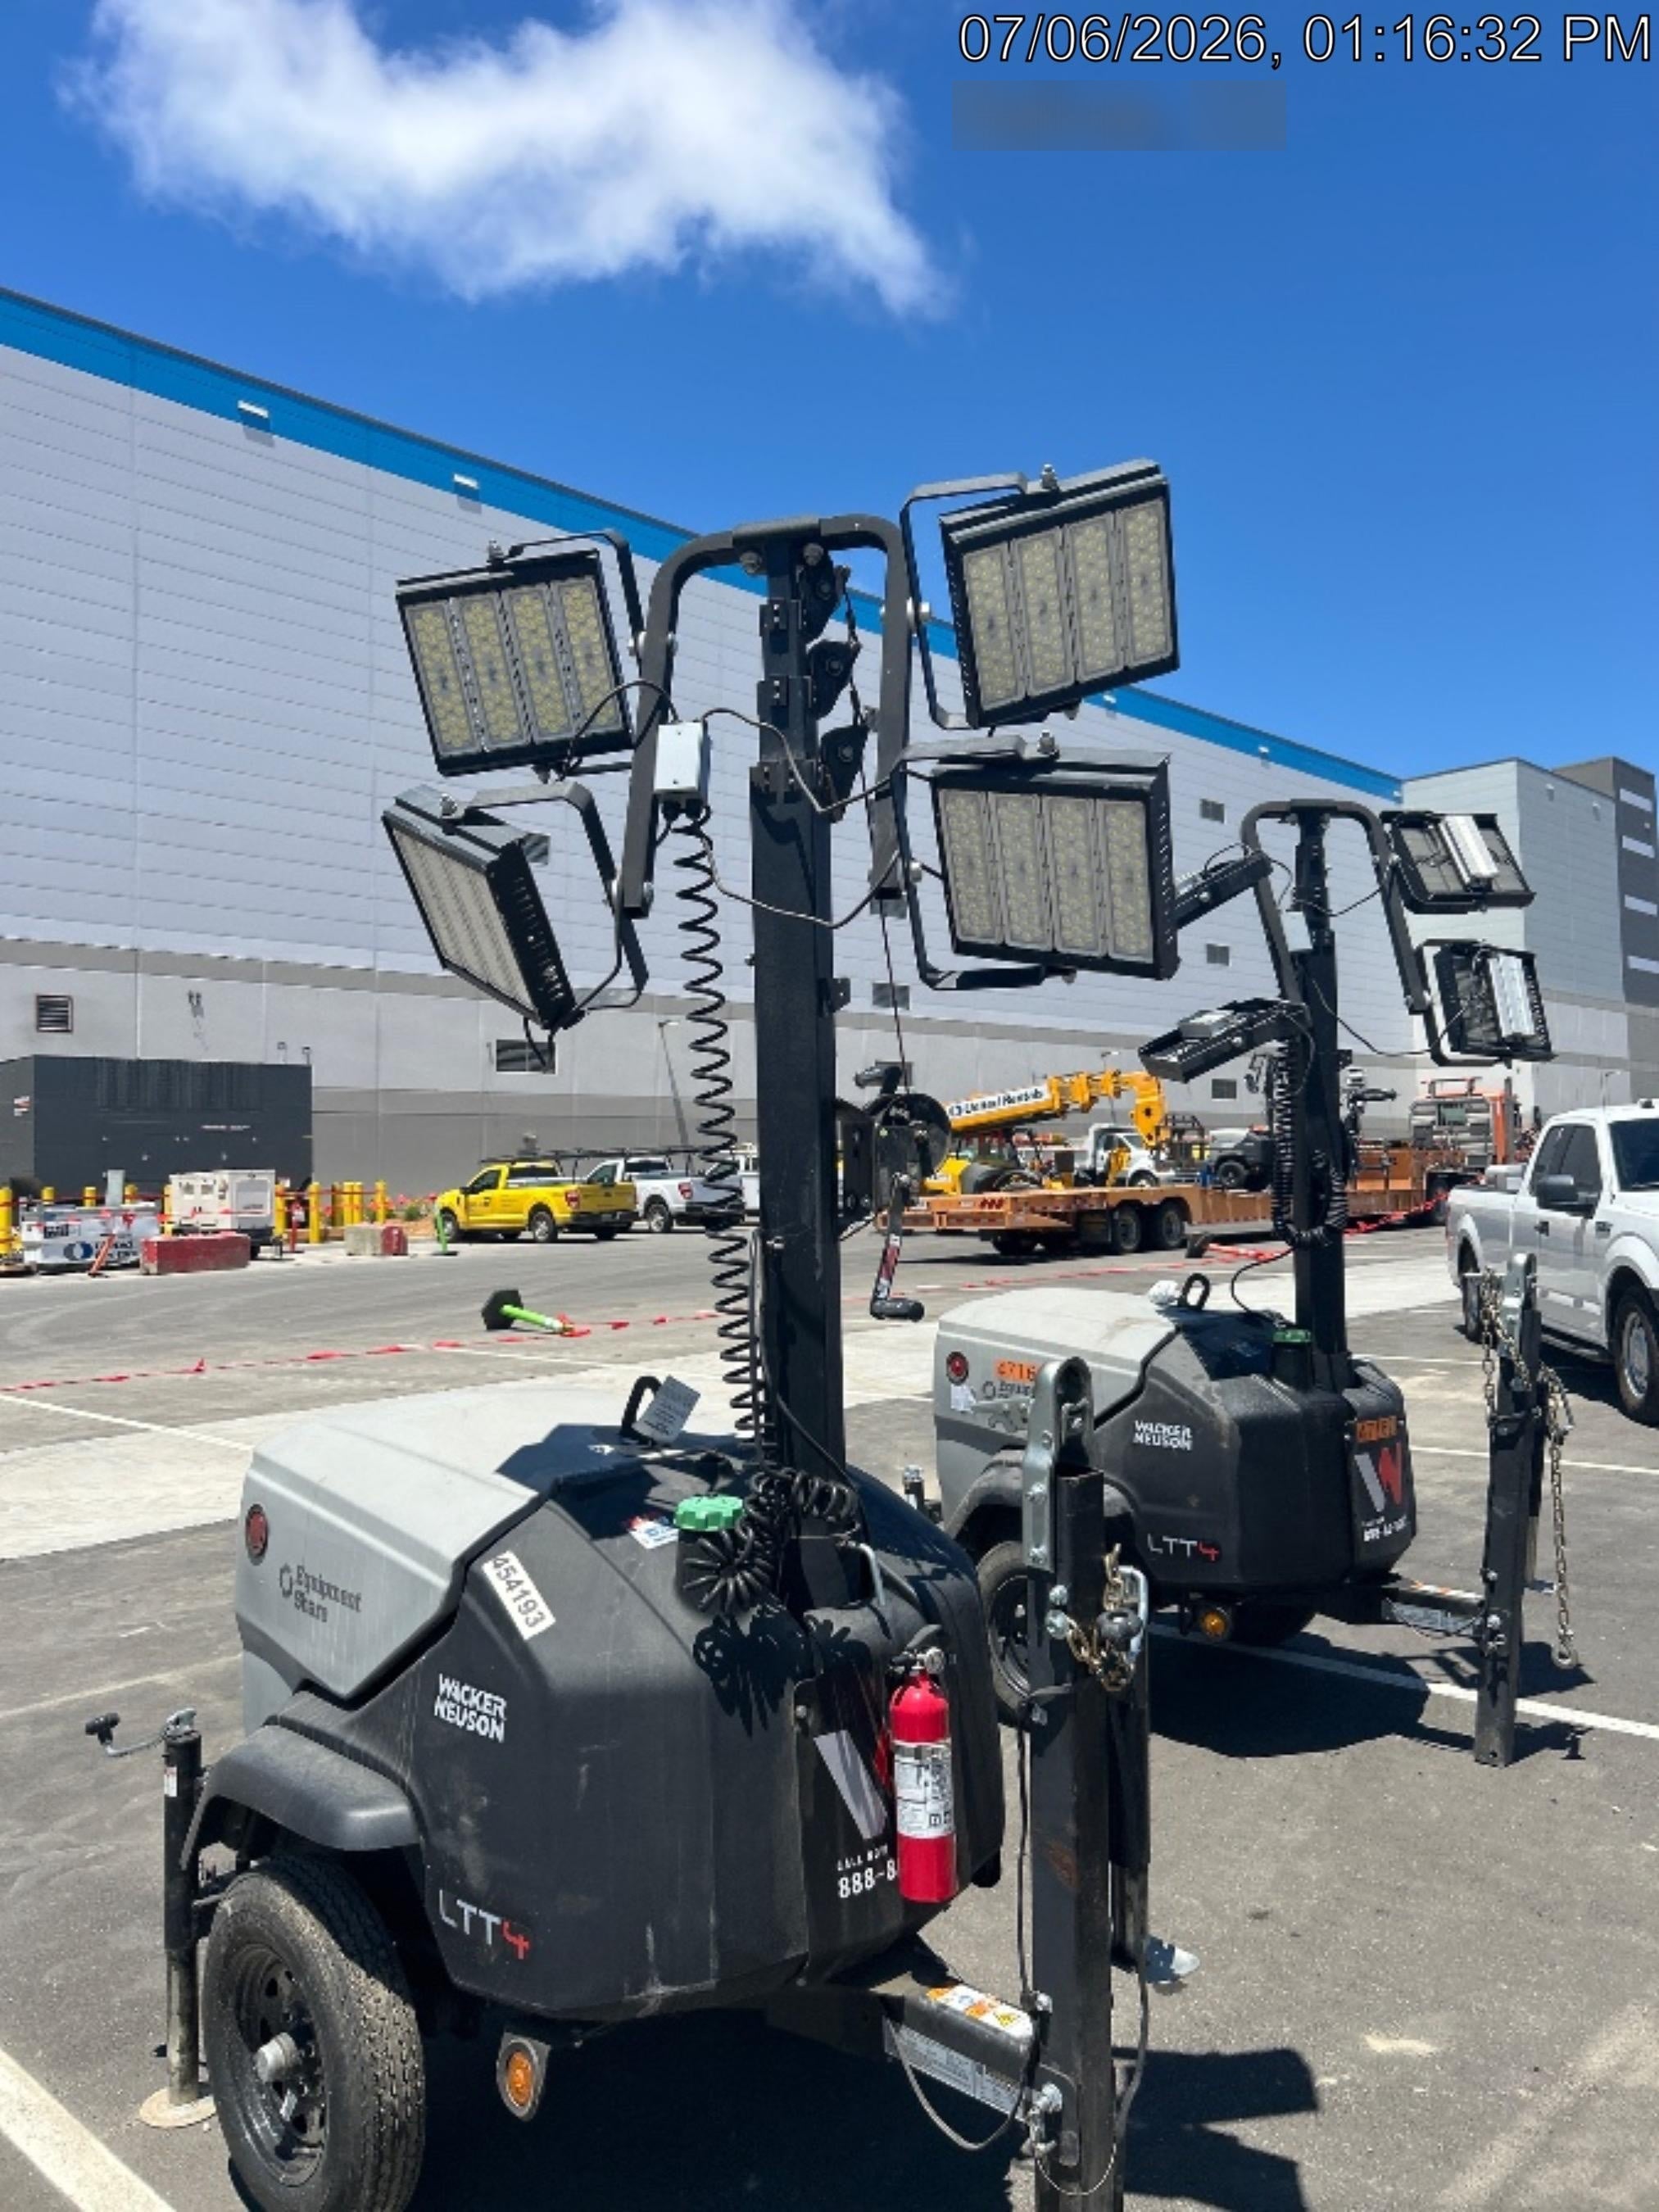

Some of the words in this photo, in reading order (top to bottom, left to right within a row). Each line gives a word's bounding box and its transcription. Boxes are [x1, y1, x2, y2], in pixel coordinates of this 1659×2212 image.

[1147, 1533, 1220, 1562] LTT4
[492, 1557, 546, 1628] 454193
[434, 1695, 505, 1743] NEUSON
[438, 1672, 506, 1721] WACKER
[438, 1888, 531, 1960] LTT4
